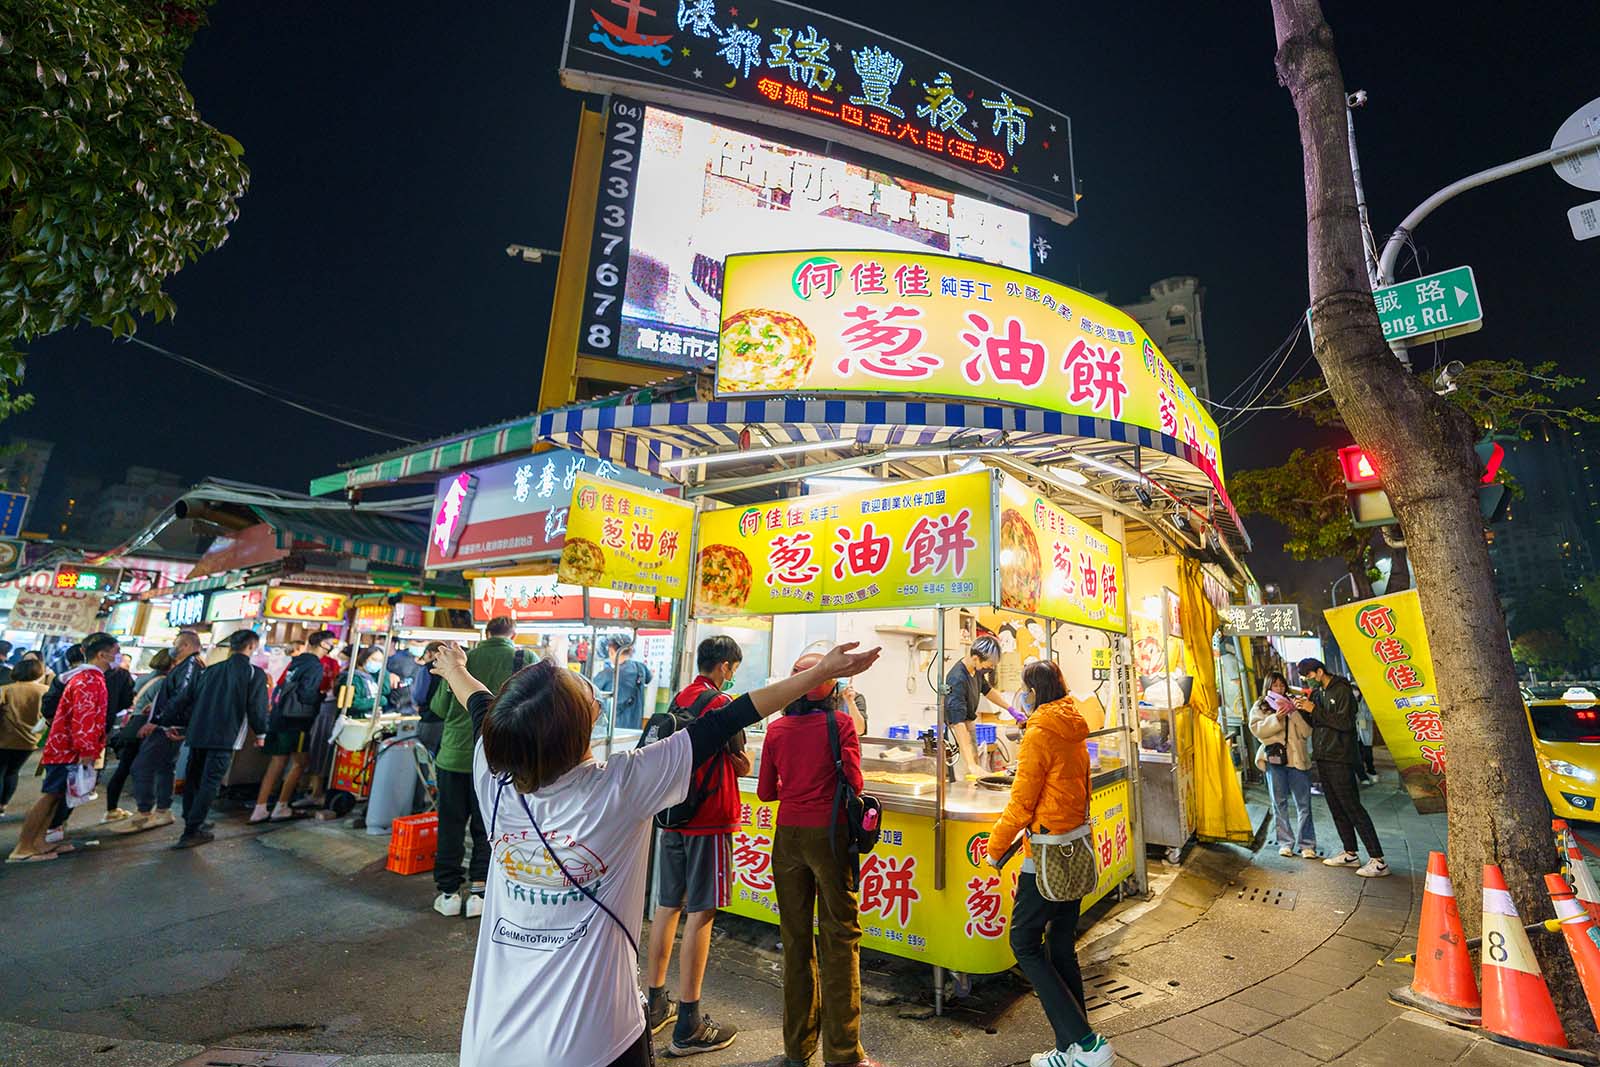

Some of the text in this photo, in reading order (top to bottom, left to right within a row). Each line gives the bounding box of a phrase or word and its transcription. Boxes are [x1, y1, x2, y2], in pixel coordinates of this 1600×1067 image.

[676, 0, 1034, 157] 港都瑞豐夜市
[612, 101, 643, 121] (04)
[587, 121, 638, 349] 22337678
[797, 261, 932, 299] 何佳佳
[940, 276, 993, 302] 純手工
[1374, 279, 1446, 315] 誠路
[1381, 303, 1454, 335] eng Rd.
[579, 487, 631, 516] 何佳佳
[1035, 502, 1066, 535] 何佳佳
[742, 505, 804, 536] 何佳佳
[809, 506, 840, 522] 純手工
[1359, 606, 1424, 692] 何佳佳
[859, 854, 919, 927] 餅
[1488, 930, 1509, 963] 8
